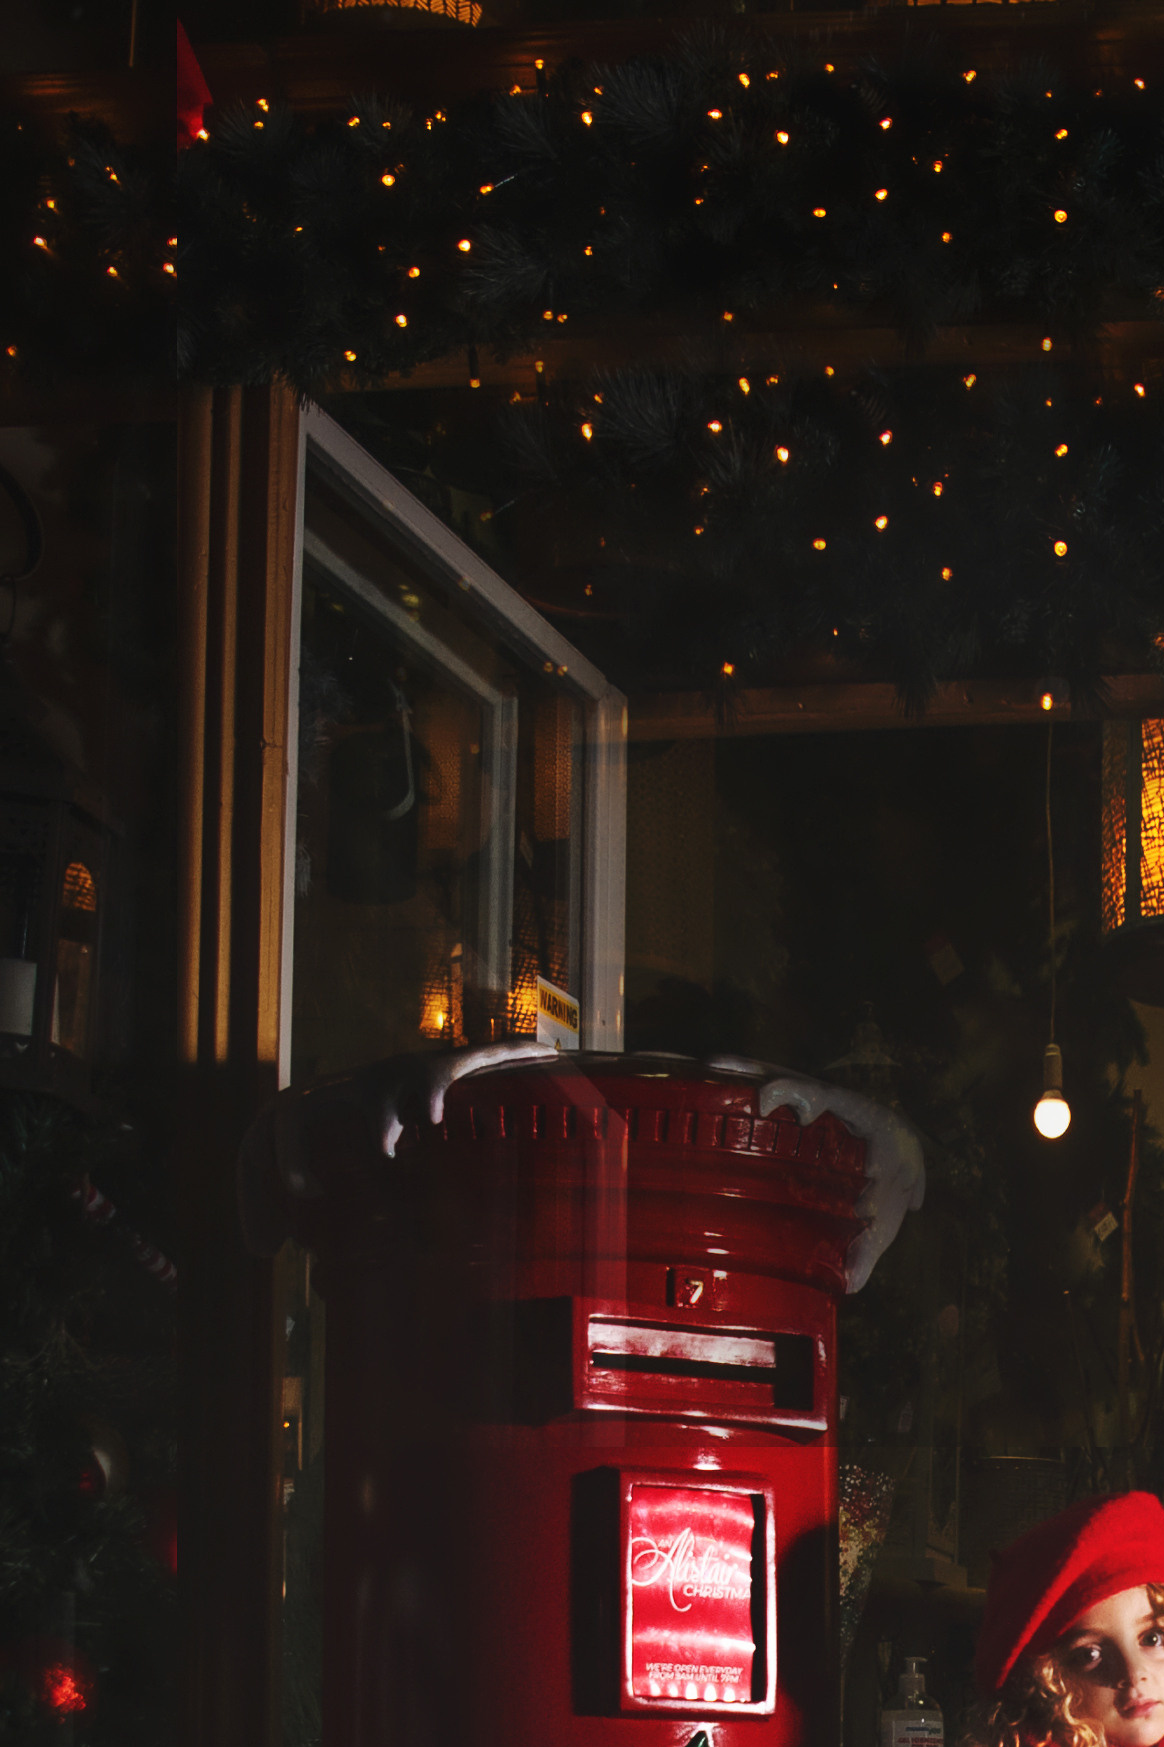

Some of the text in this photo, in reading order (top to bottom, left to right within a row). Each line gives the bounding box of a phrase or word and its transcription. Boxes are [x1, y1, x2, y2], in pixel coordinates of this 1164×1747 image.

[539, 989, 578, 1029] WARNING
[682, 1584, 751, 1600] CHRISTMA
[674, 1664, 698, 1674] OPEN
